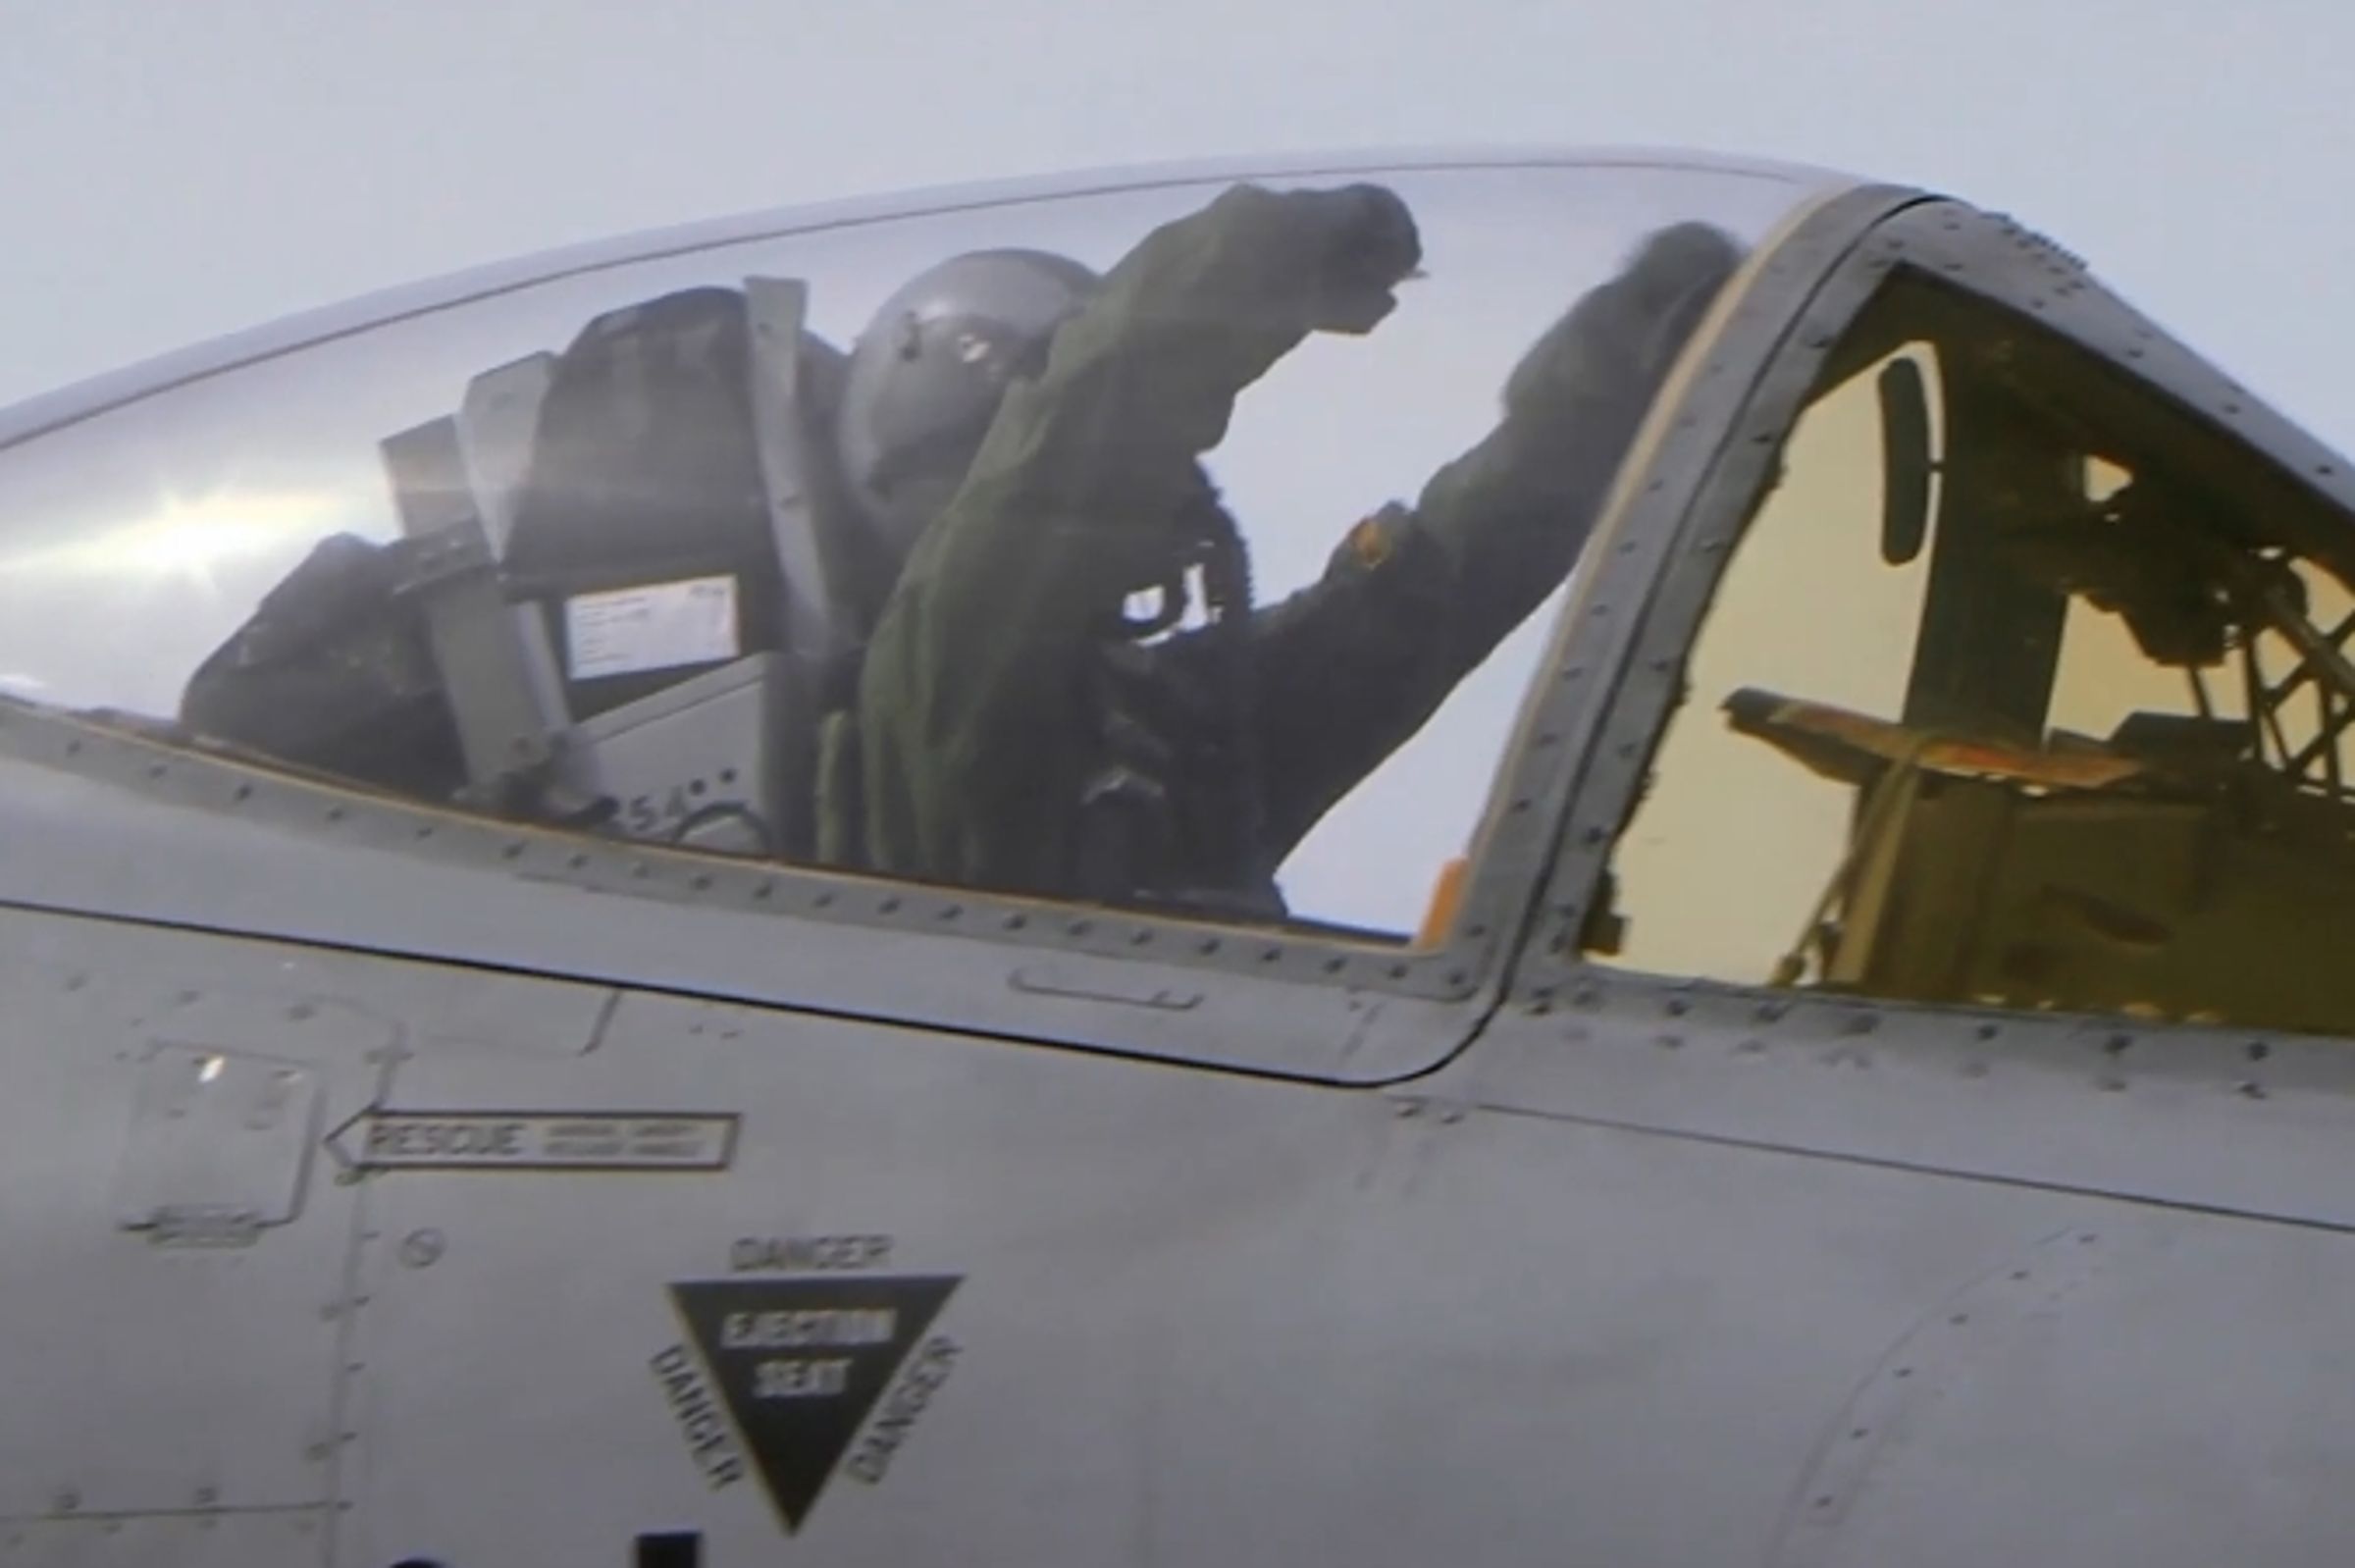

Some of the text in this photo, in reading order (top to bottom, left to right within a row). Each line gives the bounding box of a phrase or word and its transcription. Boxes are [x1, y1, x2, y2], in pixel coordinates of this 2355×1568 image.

[367, 1123, 527, 1156] RESCUE
[729, 1233, 894, 1272] DANGER
[719, 1307, 898, 1350] EJECTION
[751, 1356, 855, 1400] SEAT
[648, 1341, 744, 1491] DANGER
[844, 1334, 964, 1486] DANGER
